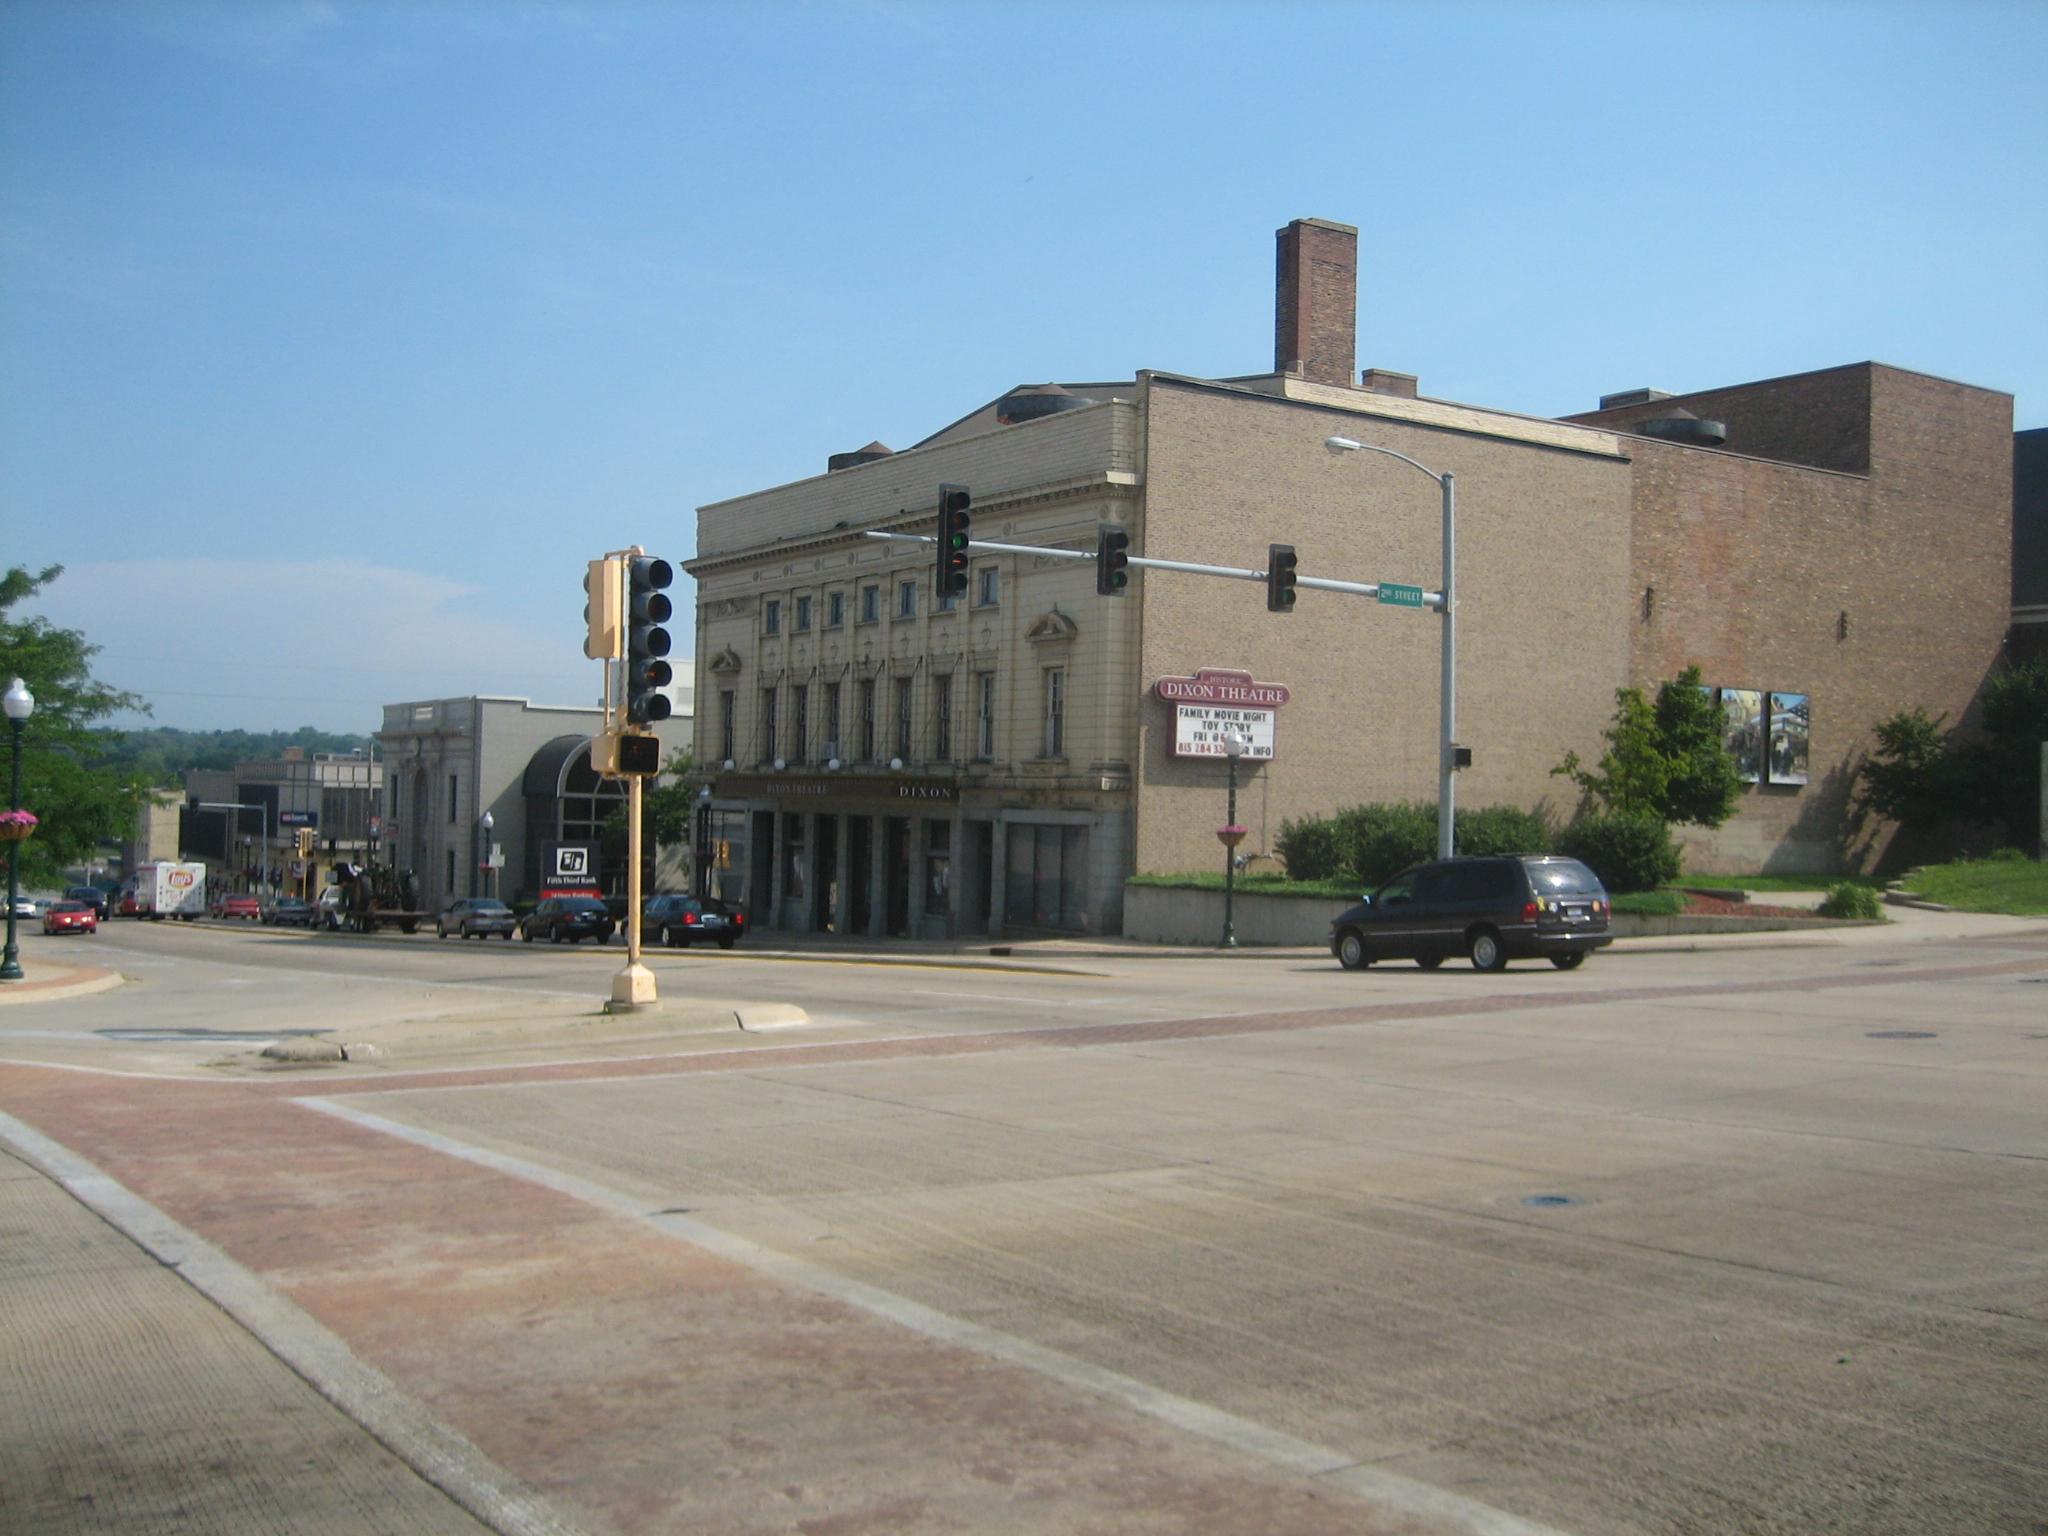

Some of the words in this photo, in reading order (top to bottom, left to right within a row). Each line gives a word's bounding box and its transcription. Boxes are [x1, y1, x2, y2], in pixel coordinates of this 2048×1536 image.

[1394, 590, 1420, 601] STREET
[1167, 682, 1213, 697] DIXON
[1219, 686, 1284, 702] THEATRE
[1179, 707, 1210, 719] FAMILY
[1214, 709, 1240, 721] MOVIE
[1243, 711, 1267, 722] NIGHT
[1202, 720, 1219, 731] TOY
[1224, 722, 1252, 733] STORY
[1193, 731, 1207, 742] FRI
[1253, 746, 1271, 756] INFO
[899, 786, 951, 799] DIXON
[547, 876, 562, 885] Fifth
[563, 876, 580, 885] Third
[581, 876, 596, 885] Bank
